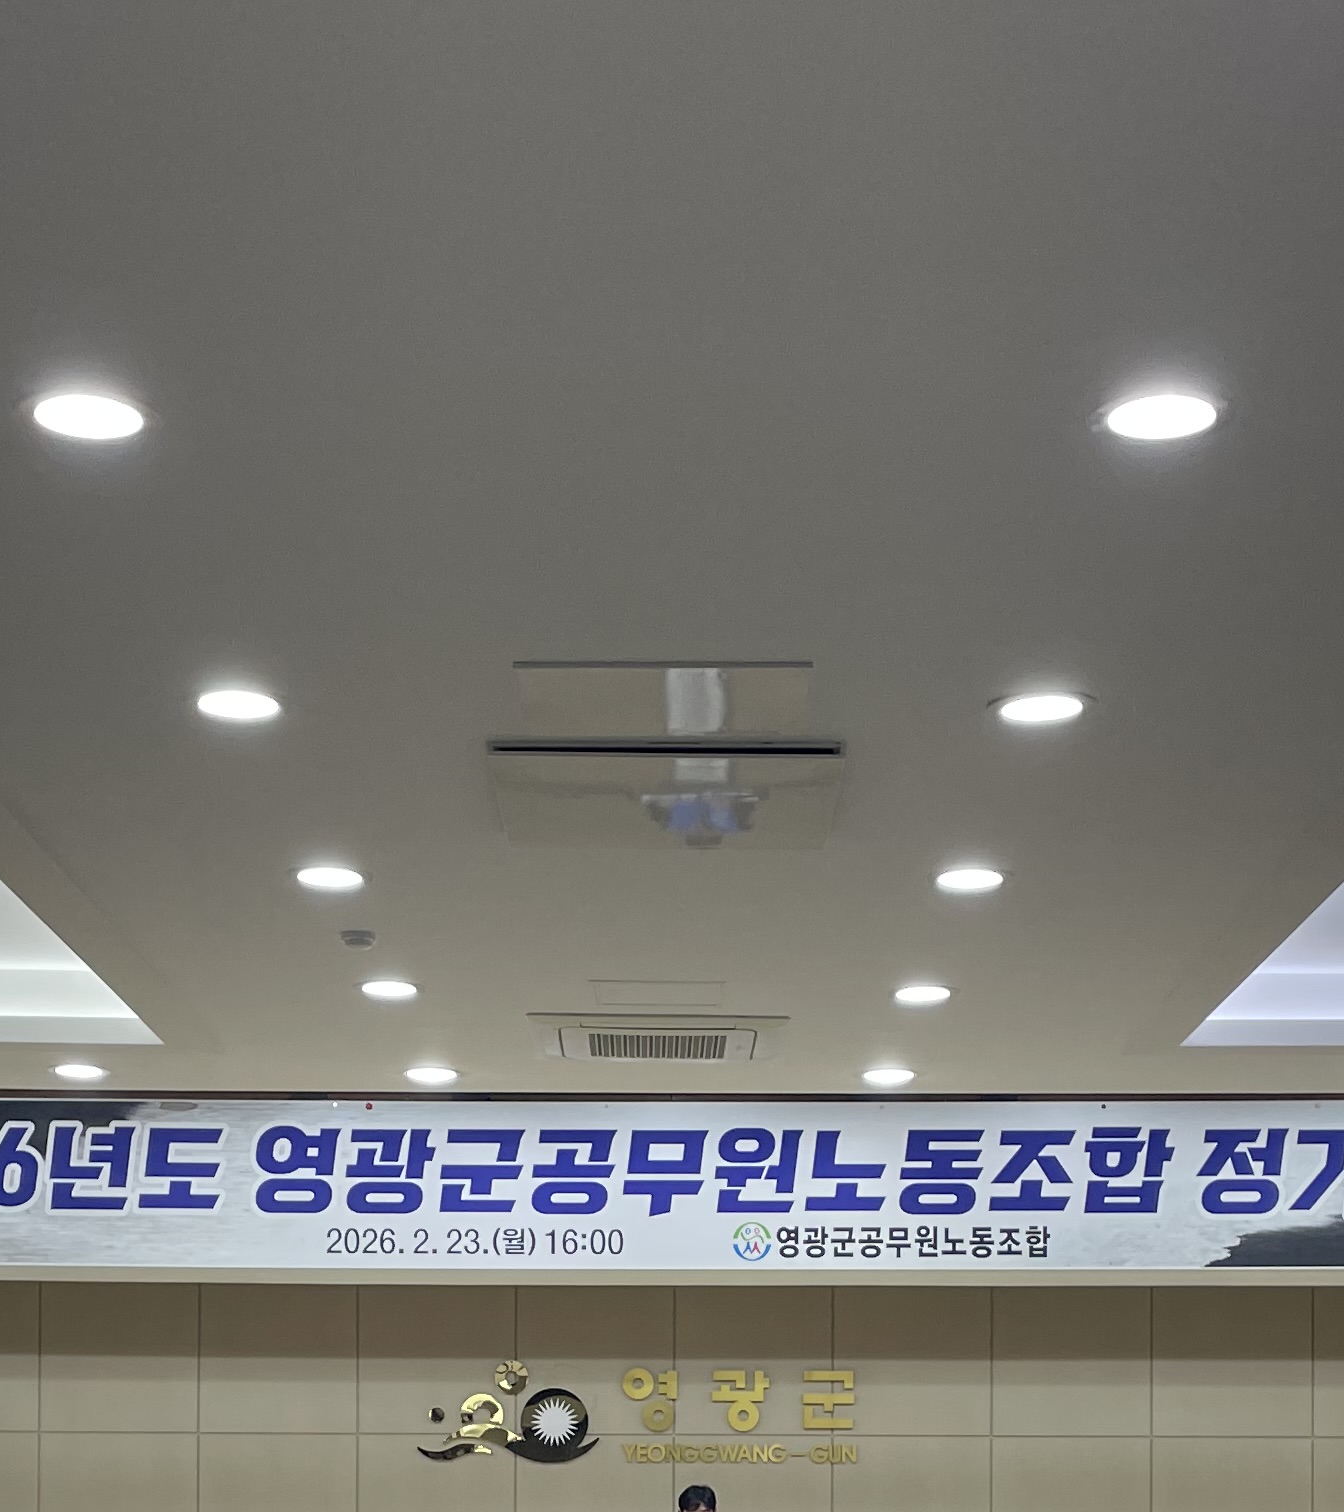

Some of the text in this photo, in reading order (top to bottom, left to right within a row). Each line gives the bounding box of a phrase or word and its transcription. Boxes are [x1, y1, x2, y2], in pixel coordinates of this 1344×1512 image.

[255, 1124, 1174, 1216] 영광군공무원노동조합
[326, 1228, 404, 1254] 2026.
[545, 1229, 624, 1254] 16:00
[776, 1225, 1051, 1258] 영광군공무원노동조합
